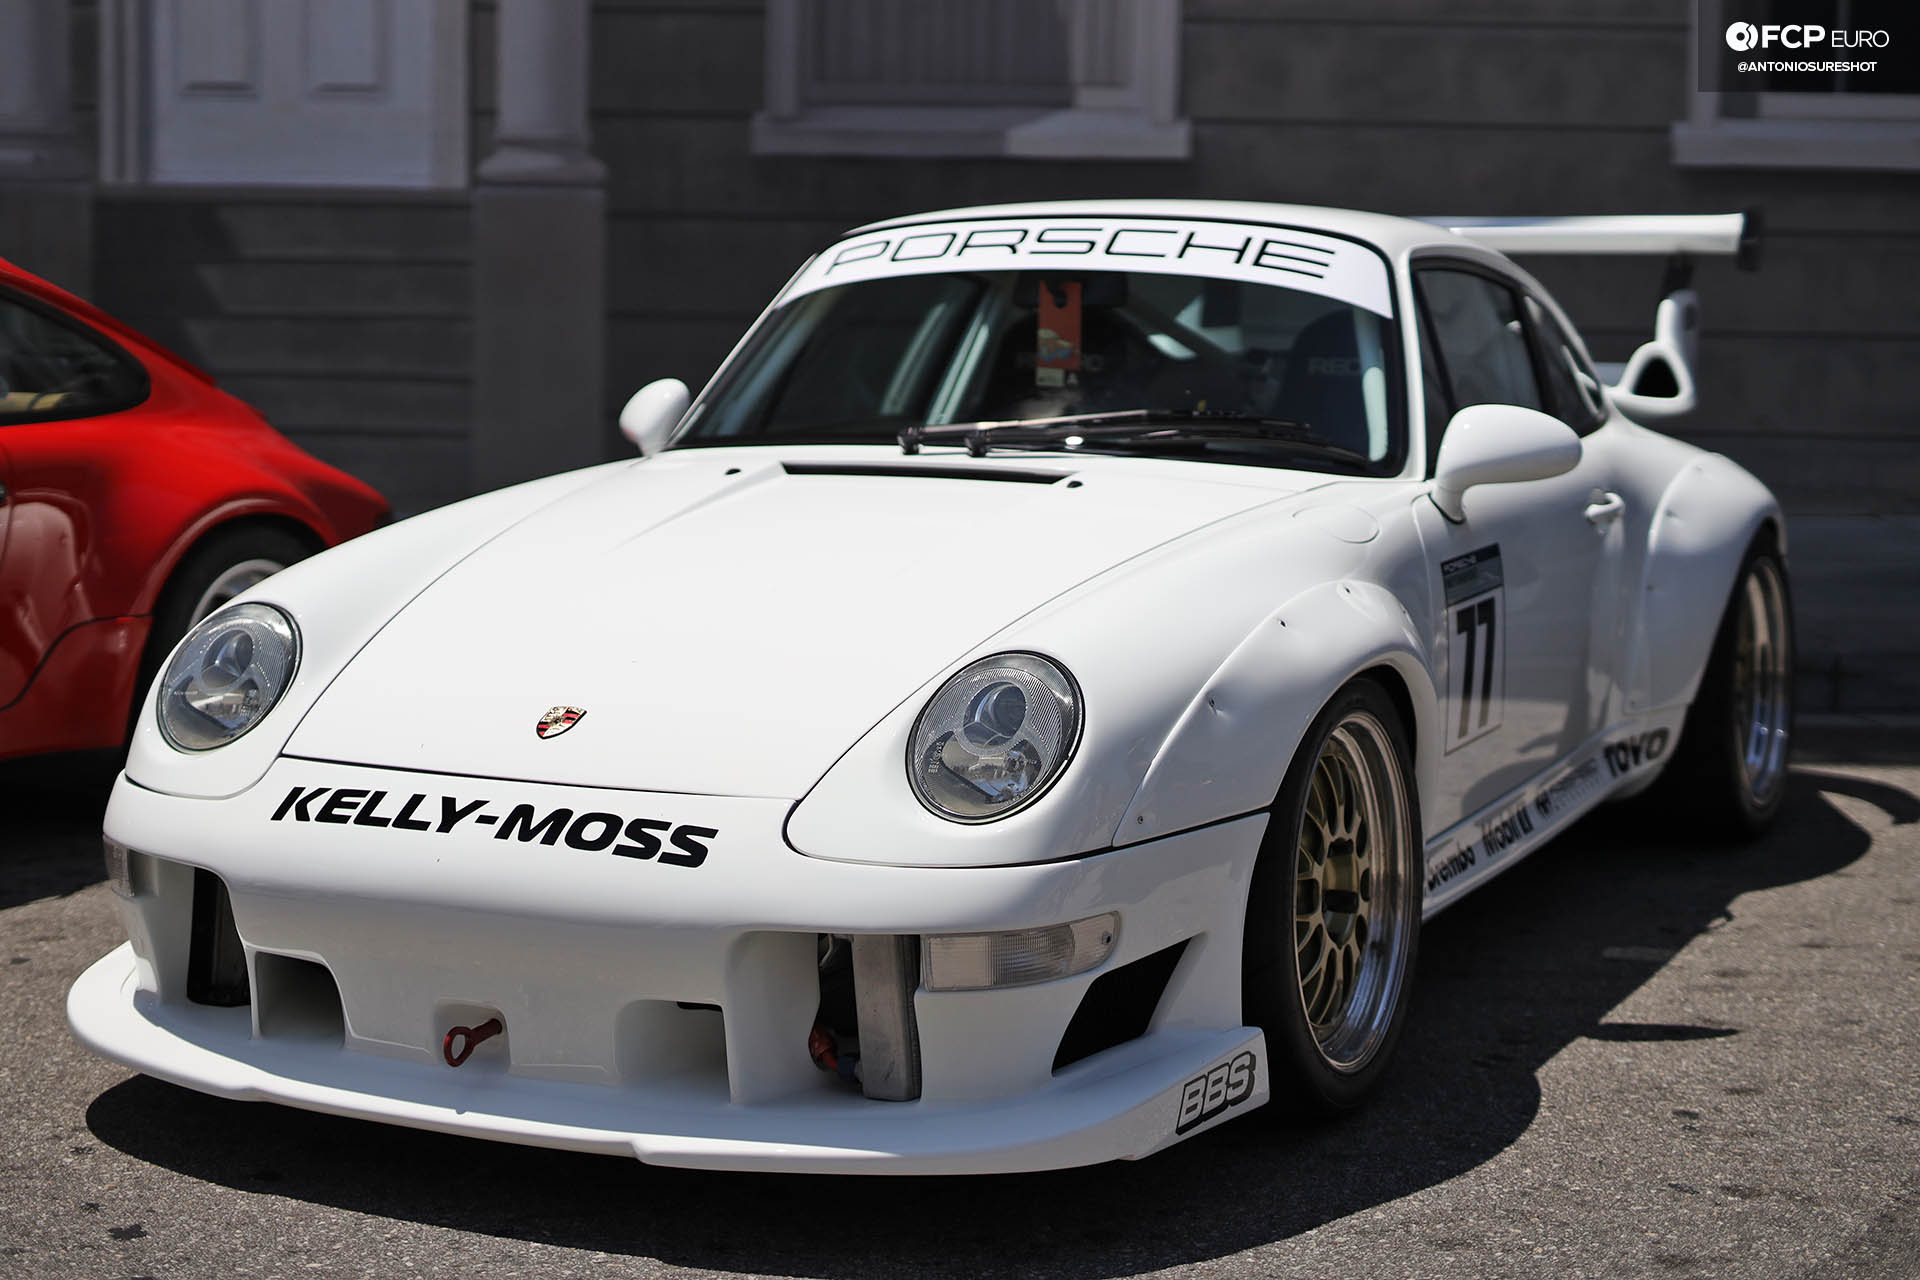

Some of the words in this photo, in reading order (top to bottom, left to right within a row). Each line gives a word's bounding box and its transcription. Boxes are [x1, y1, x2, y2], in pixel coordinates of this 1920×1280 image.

[825, 227, 1336, 280] PORSCHE
[1456, 596, 1496, 739] 77
[1603, 727, 1671, 779] TOYO
[270, 786, 720, 869] KELLY-MOSS
[1175, 1050, 1257, 1136] BBS
